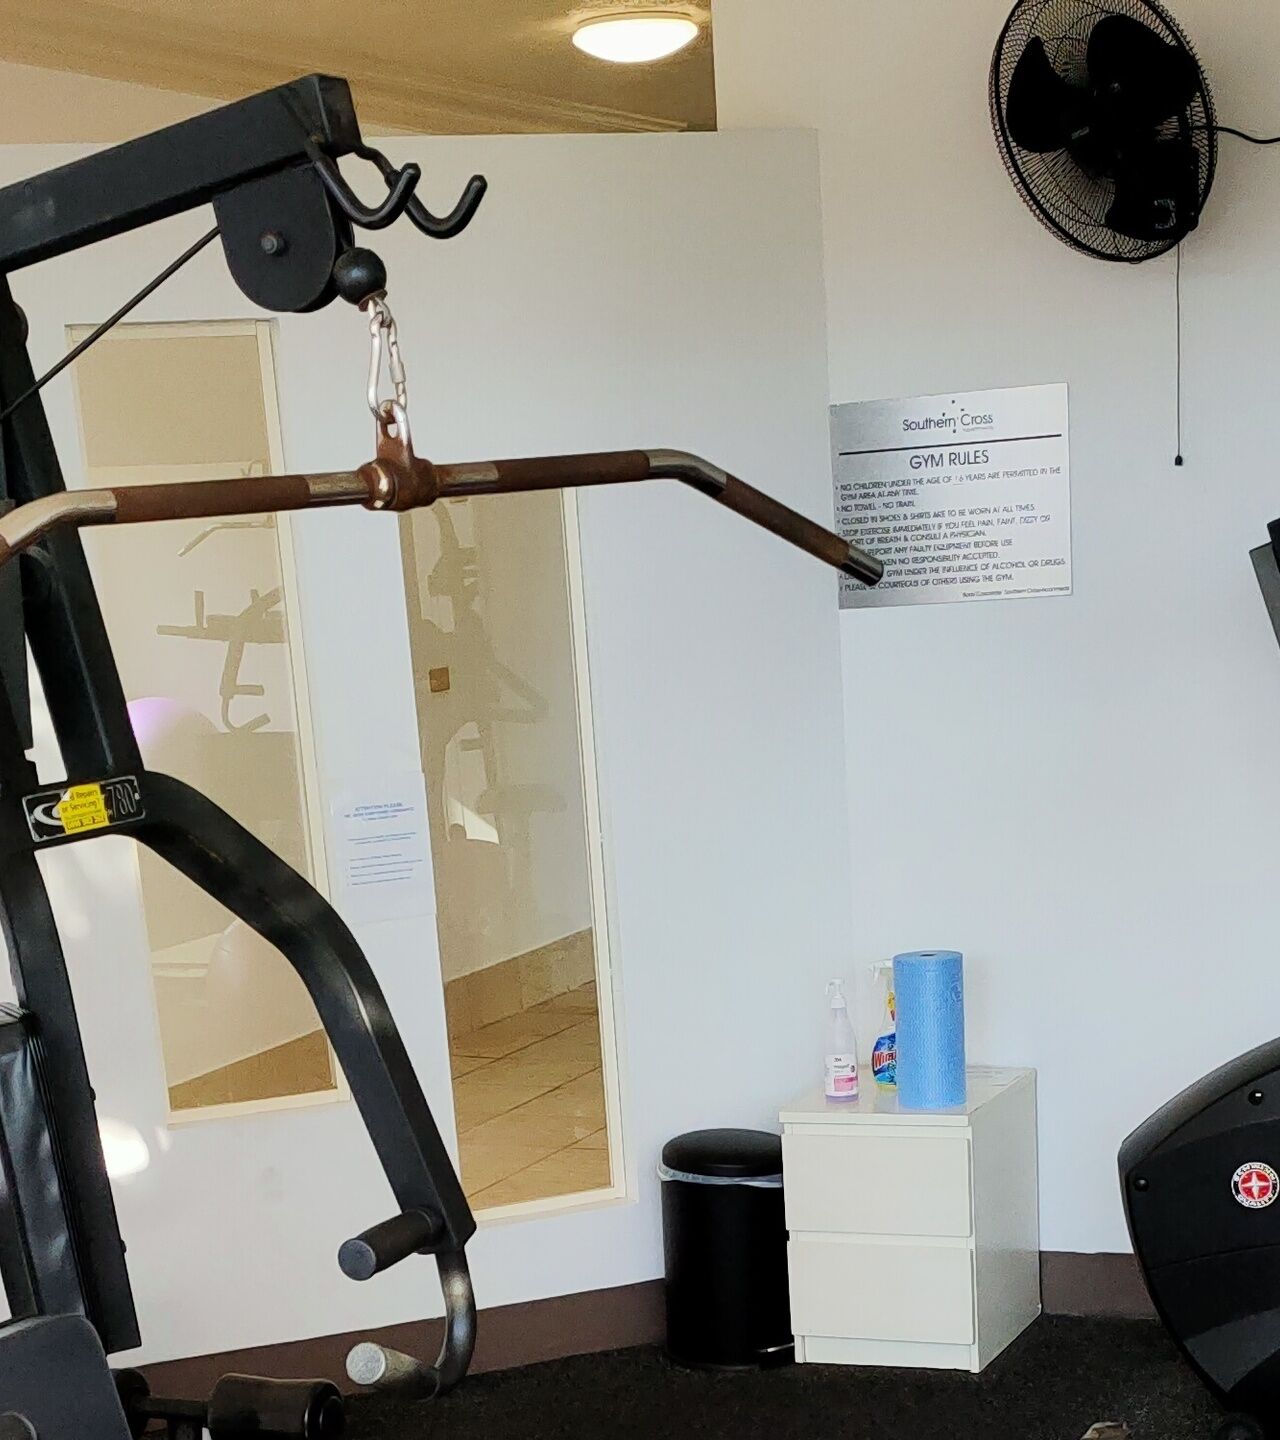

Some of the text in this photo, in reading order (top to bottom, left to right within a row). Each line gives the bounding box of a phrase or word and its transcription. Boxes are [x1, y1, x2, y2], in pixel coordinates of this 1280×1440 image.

[902, 416, 956, 432] Southern
[960, 413, 994, 427] Cross
[909, 449, 990, 470] GYM RULES
[840, 484, 852, 492] NO
[853, 482, 887, 491] CHILDREN
[912, 478, 924, 486] THE
[926, 476, 941, 485] AGE
[942, 475, 953, 484] OF
[965, 473, 987, 482] YEARS
[987, 471, 1001, 480] ARE
[1002, 468, 1039, 478] PERMITTED
[1049, 466, 1062, 474] THE
[841, 504, 853, 512] NO
[882, 501, 894, 509] NO
[841, 515, 870, 525] CLOSED
[932, 510, 946, 518] ARE
[947, 509, 957, 517] TO
[967, 507, 991, 516] WORN
[865, 537, 875, 545] OF
[973, 540, 999, 549] BEFORE
[1000, 538, 1013, 547] USE
[887, 569, 903, 577] GYM
[904, 567, 927, 576] UNDER
[928, 566, 940, 574] THE
[980, 563, 990, 571] OF
[992, 561, 1026, 570] ALCOHOL
[1027, 559, 1039, 568] OR
[898, 557, 910, 565] NO
[919, 578, 930, 586] OF
[981, 574, 994, 582] THE
[106, 783, 137, 819] 780
